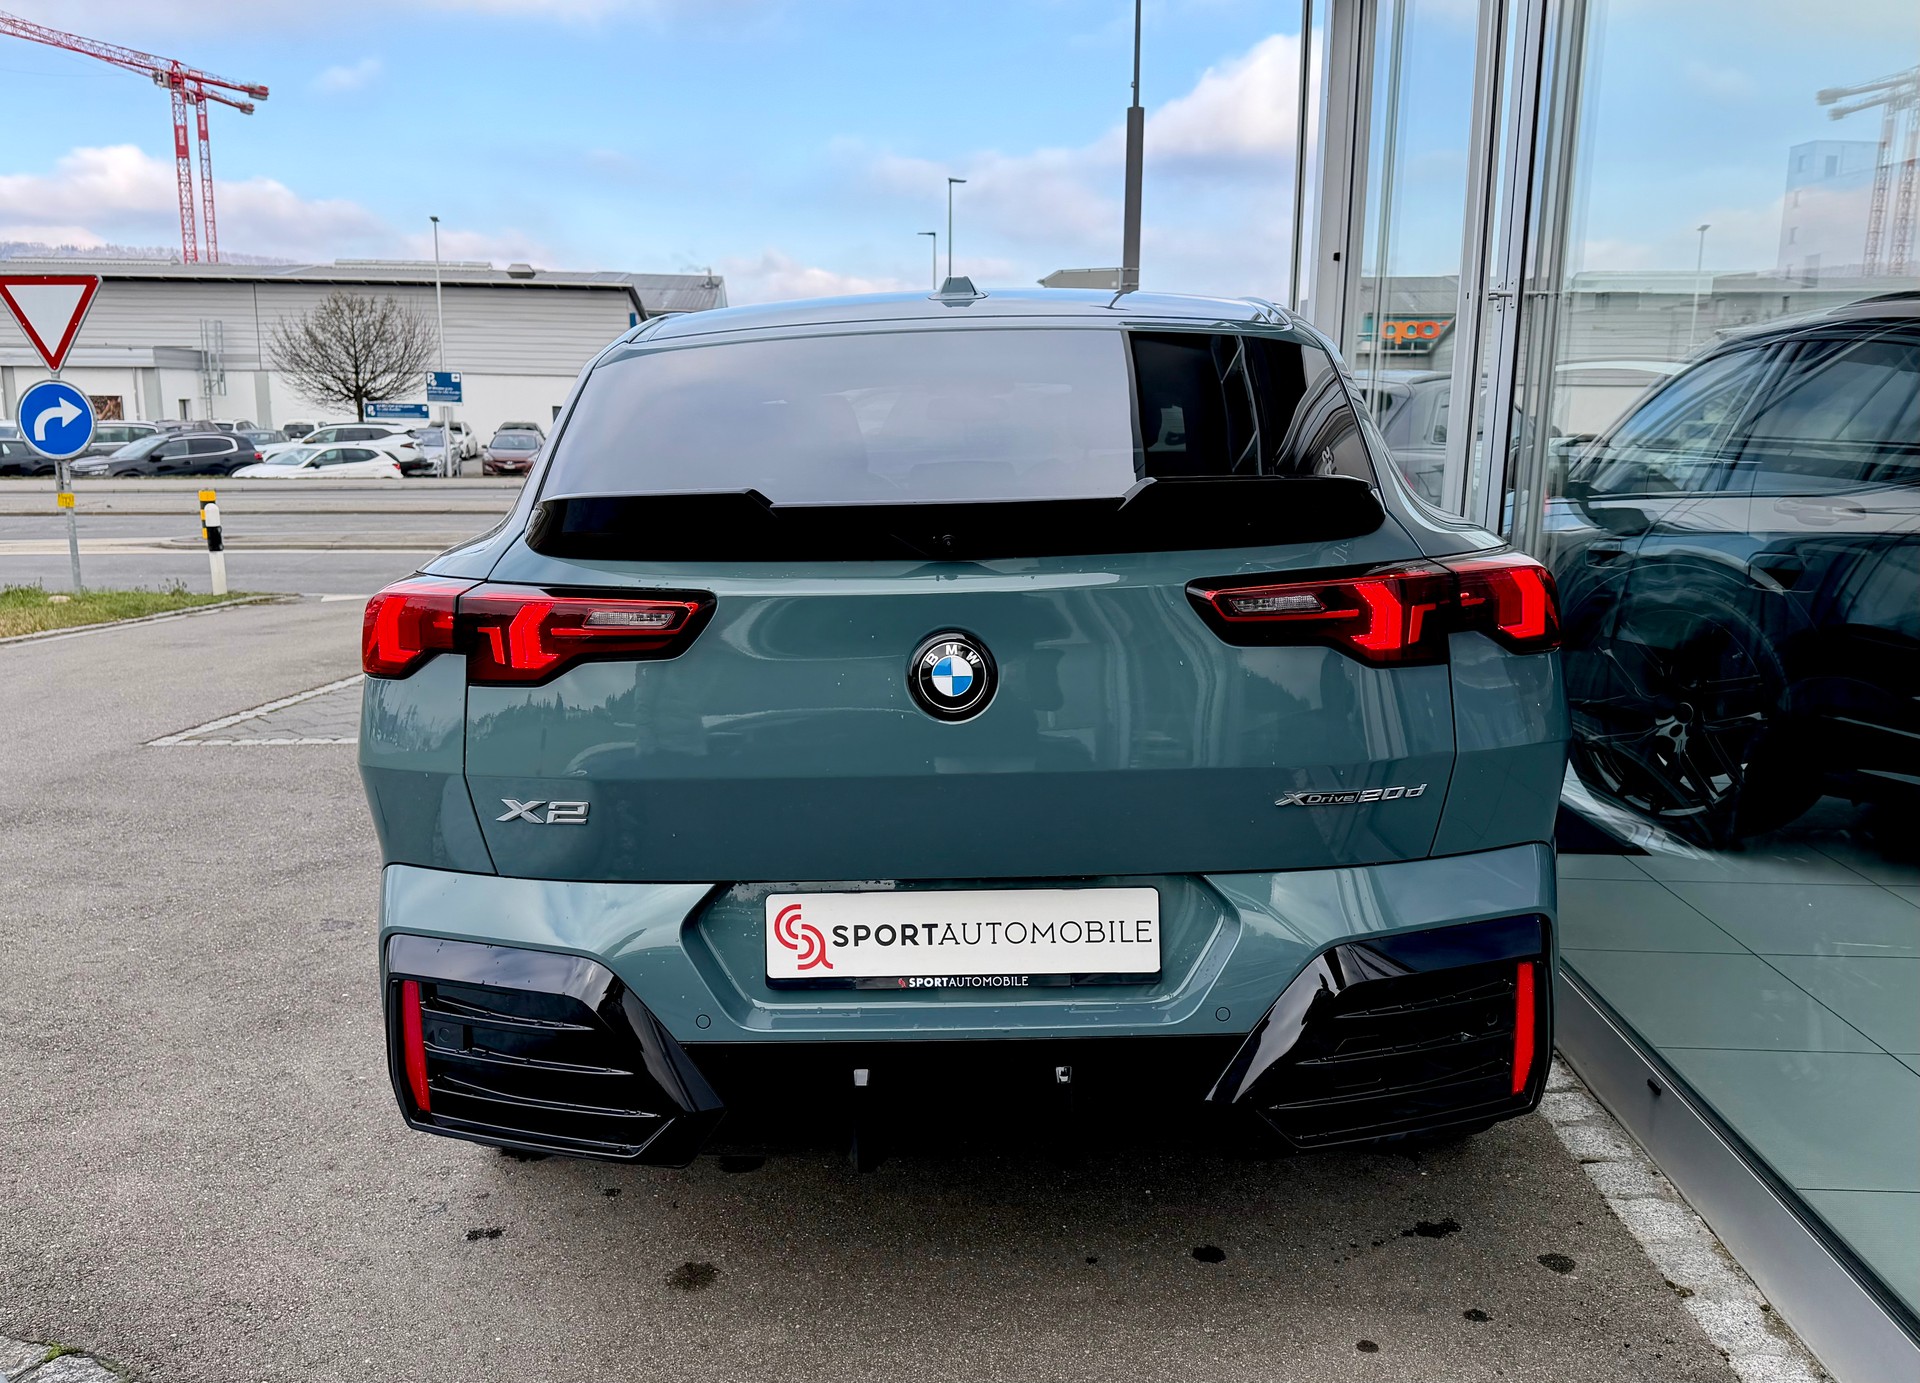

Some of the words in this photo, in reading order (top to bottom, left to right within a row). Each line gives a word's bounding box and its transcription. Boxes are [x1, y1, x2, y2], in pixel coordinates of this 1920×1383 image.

[925, 644, 981, 666] BMW
[495, 798, 590, 824] X2
[832, 920, 1153, 947] SPORTAUTOMOBILE
[909, 975, 1029, 988] SPORTAUTOMOBILE
